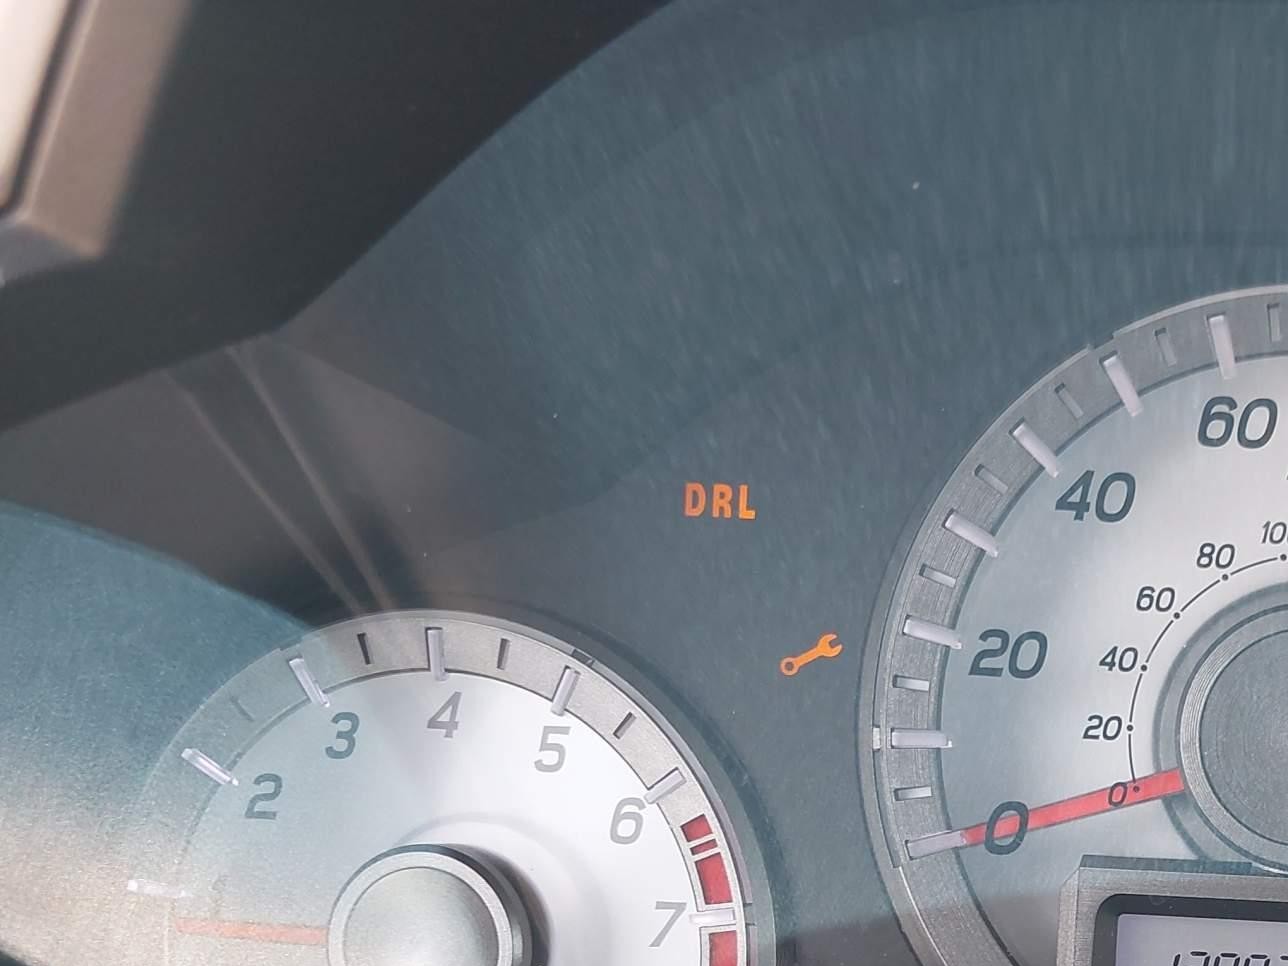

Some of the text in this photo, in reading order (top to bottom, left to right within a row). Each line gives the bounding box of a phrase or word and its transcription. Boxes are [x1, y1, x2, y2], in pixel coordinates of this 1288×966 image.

[1197, 396, 1278, 449] 60
[684, 482, 756, 519] DRL
[1055, 469, 1136, 523] 40
[1196, 543, 1235, 569] 80
[1136, 586, 1176, 612] 60
[968, 629, 1048, 679] 20
[1099, 646, 1139, 673] 40
[324, 711, 360, 759] 3
[426, 691, 463, 739] 4
[1082, 714, 1122, 741] 20
[534, 725, 571, 773] 5
[243, 772, 283, 820] 2
[1107, 781, 1129, 807] 0
[609, 797, 647, 844] 6
[983, 800, 1029, 855] 0
[647, 901, 687, 948] 7
